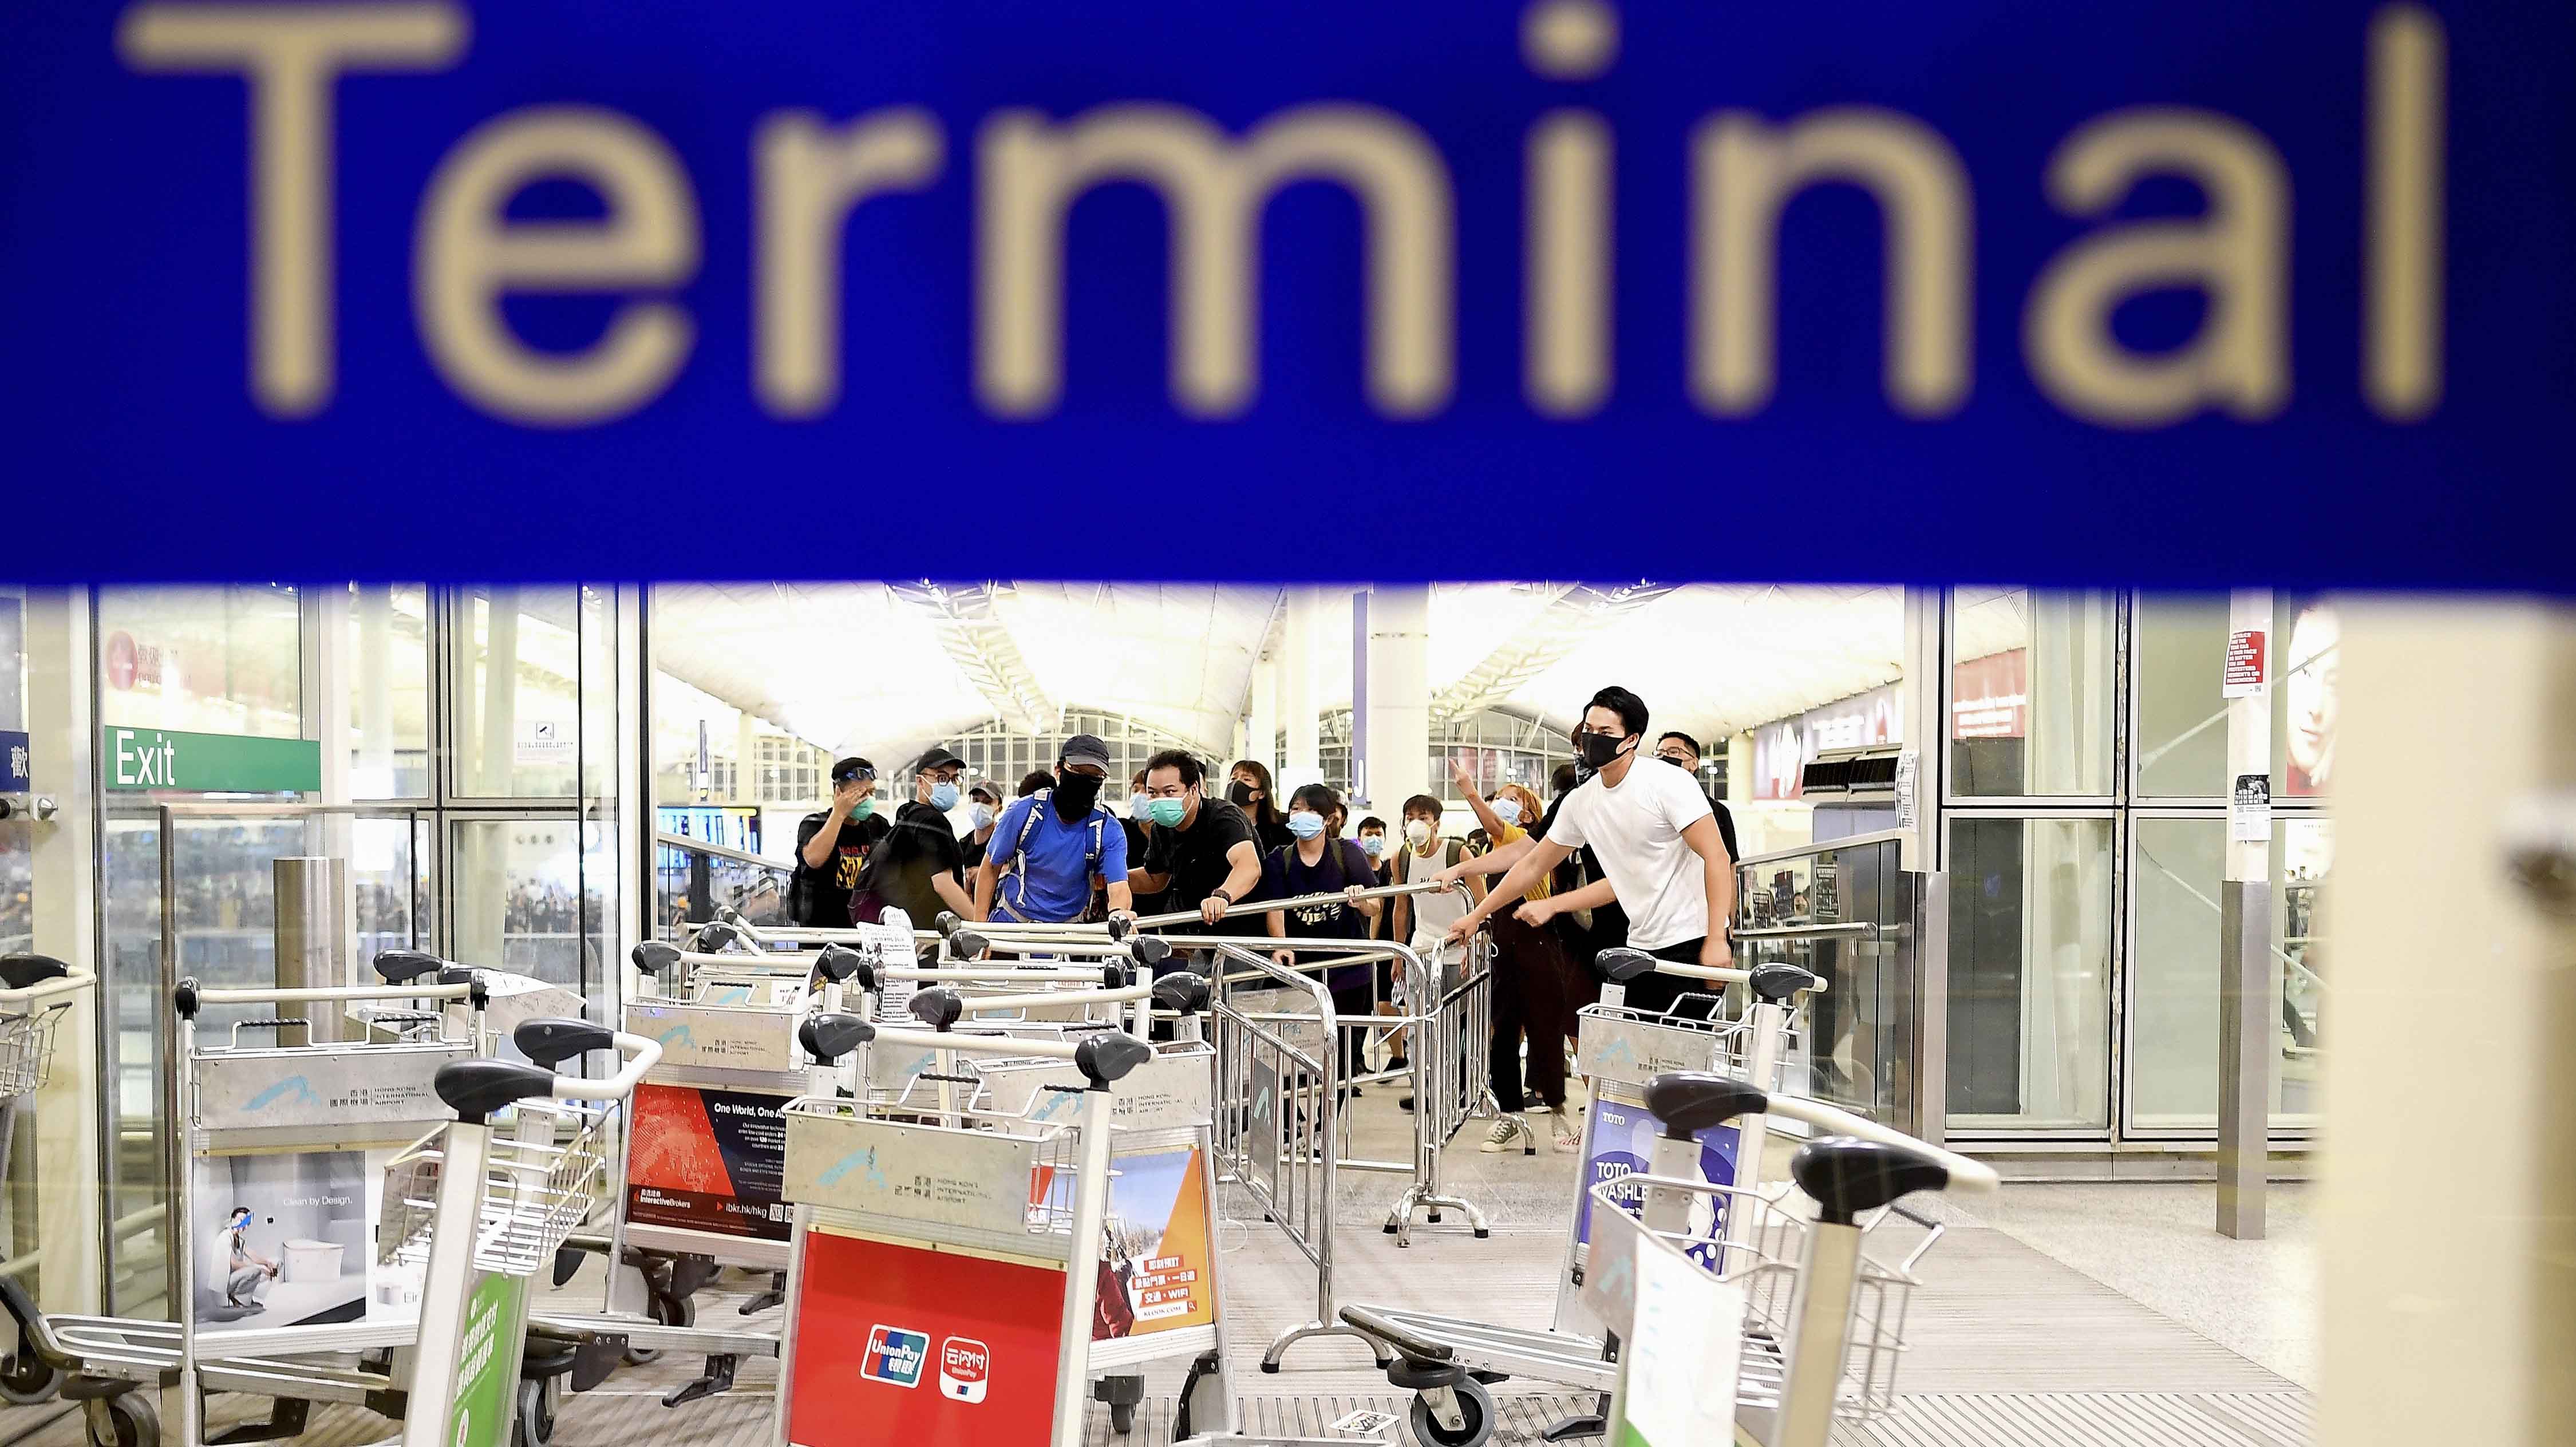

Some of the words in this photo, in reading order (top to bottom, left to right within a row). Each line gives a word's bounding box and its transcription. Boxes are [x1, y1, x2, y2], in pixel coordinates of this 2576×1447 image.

[119, 0, 2449, 428] Terminal
[116, 730, 175, 785] Exit
[714, 1102, 731, 1114] One
[732, 1104, 756, 1118] World,
[757, 1106, 775, 1118] One
[1603, 1112, 1625, 1126] TOTO
[1596, 1161, 1631, 1180] TOTO
[283, 1196, 307, 1205] Clean
[309, 1196, 320, 1207] by
[322, 1196, 353, 1207] Design.
[726, 1203, 767, 1219] ibkr.hk/hkg
[871, 1338, 921, 1365] UnionPay
[951, 1366, 977, 1379] UnionPay
